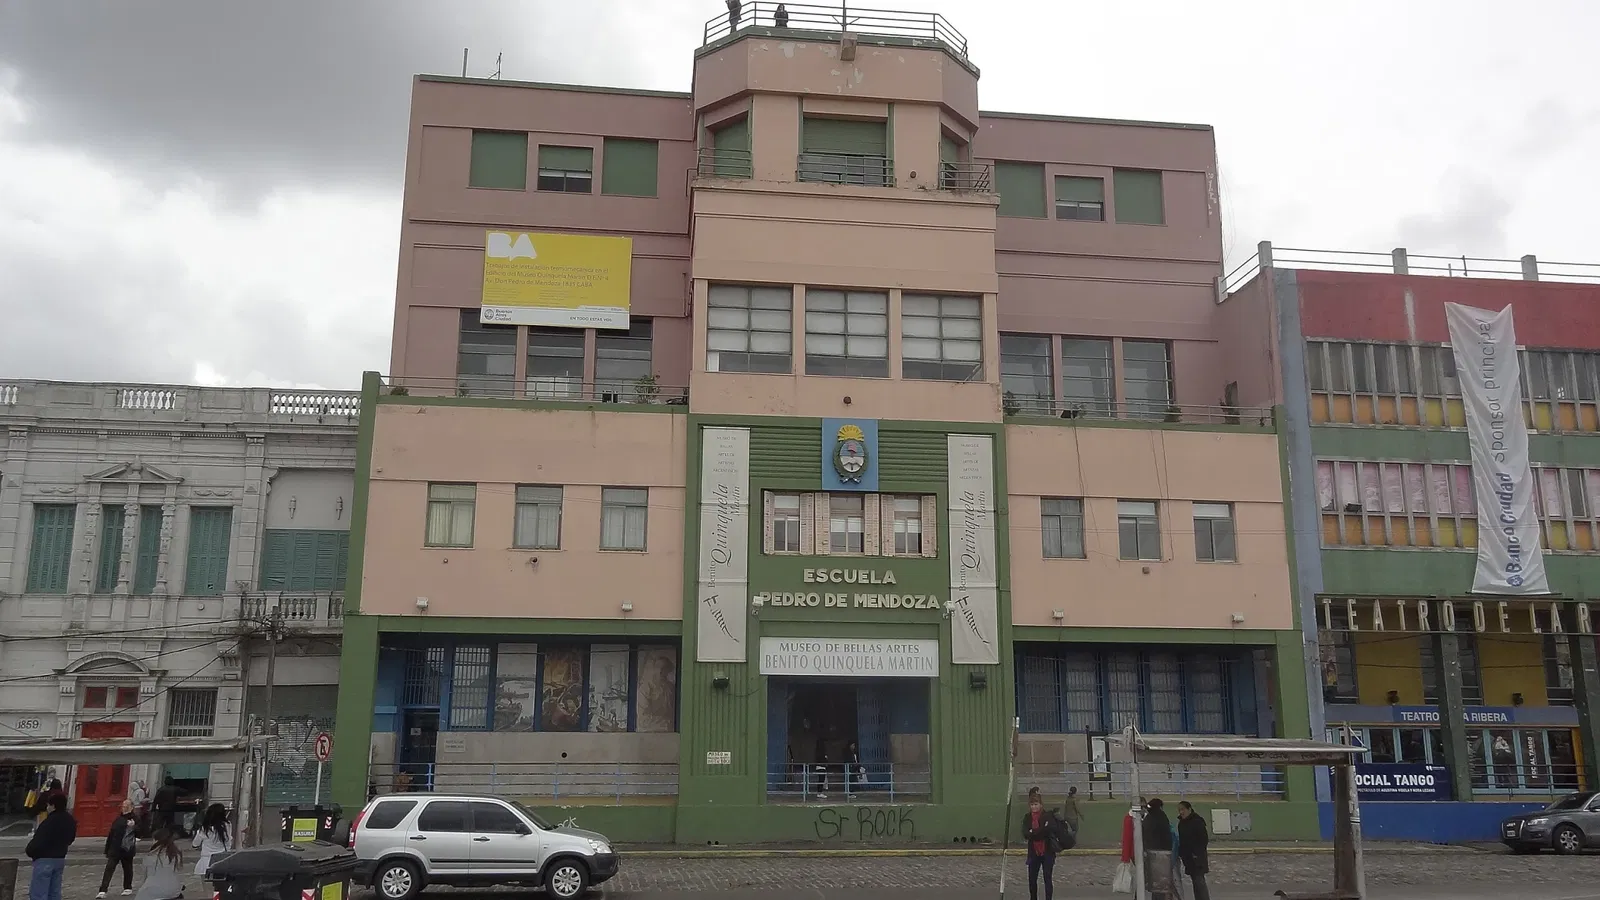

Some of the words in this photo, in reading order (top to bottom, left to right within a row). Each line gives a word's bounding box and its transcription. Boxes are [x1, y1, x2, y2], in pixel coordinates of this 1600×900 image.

[710, 483, 733, 568] Quinquela
[959, 490, 981, 573] Quinquela
[708, 560, 716, 588] Benito
[803, 568, 897, 584] ESCUELA
[959, 564, 967, 592] Benito
[759, 591, 821, 607] PEDRO
[824, 593, 848, 608] DE
[853, 593, 941, 609] MENDOZA
[1322, 598, 1455, 632] TEATRO
[1473, 601, 1511, 633] DE
[1529, 602, 1563, 634] LA
[779, 642, 821, 653] MUSEO
[825, 643, 840, 653] DE
[843, 644, 882, 653] BELLAS
[886, 644, 920, 654] ARTES
[765, 654, 809, 669] BENITO
[813, 655, 884, 673] QUINQUELA
[16, 719, 39, 729] 1859
[1401, 711, 1440, 721] TEATRO
[1471, 713, 1508, 722] RIBERA
[1354, 774, 1391, 786] OCIAL
[1394, 774, 1435, 786] TANGO
[814, 808, 849, 839] Sr
[857, 806, 914, 840] ROCK
